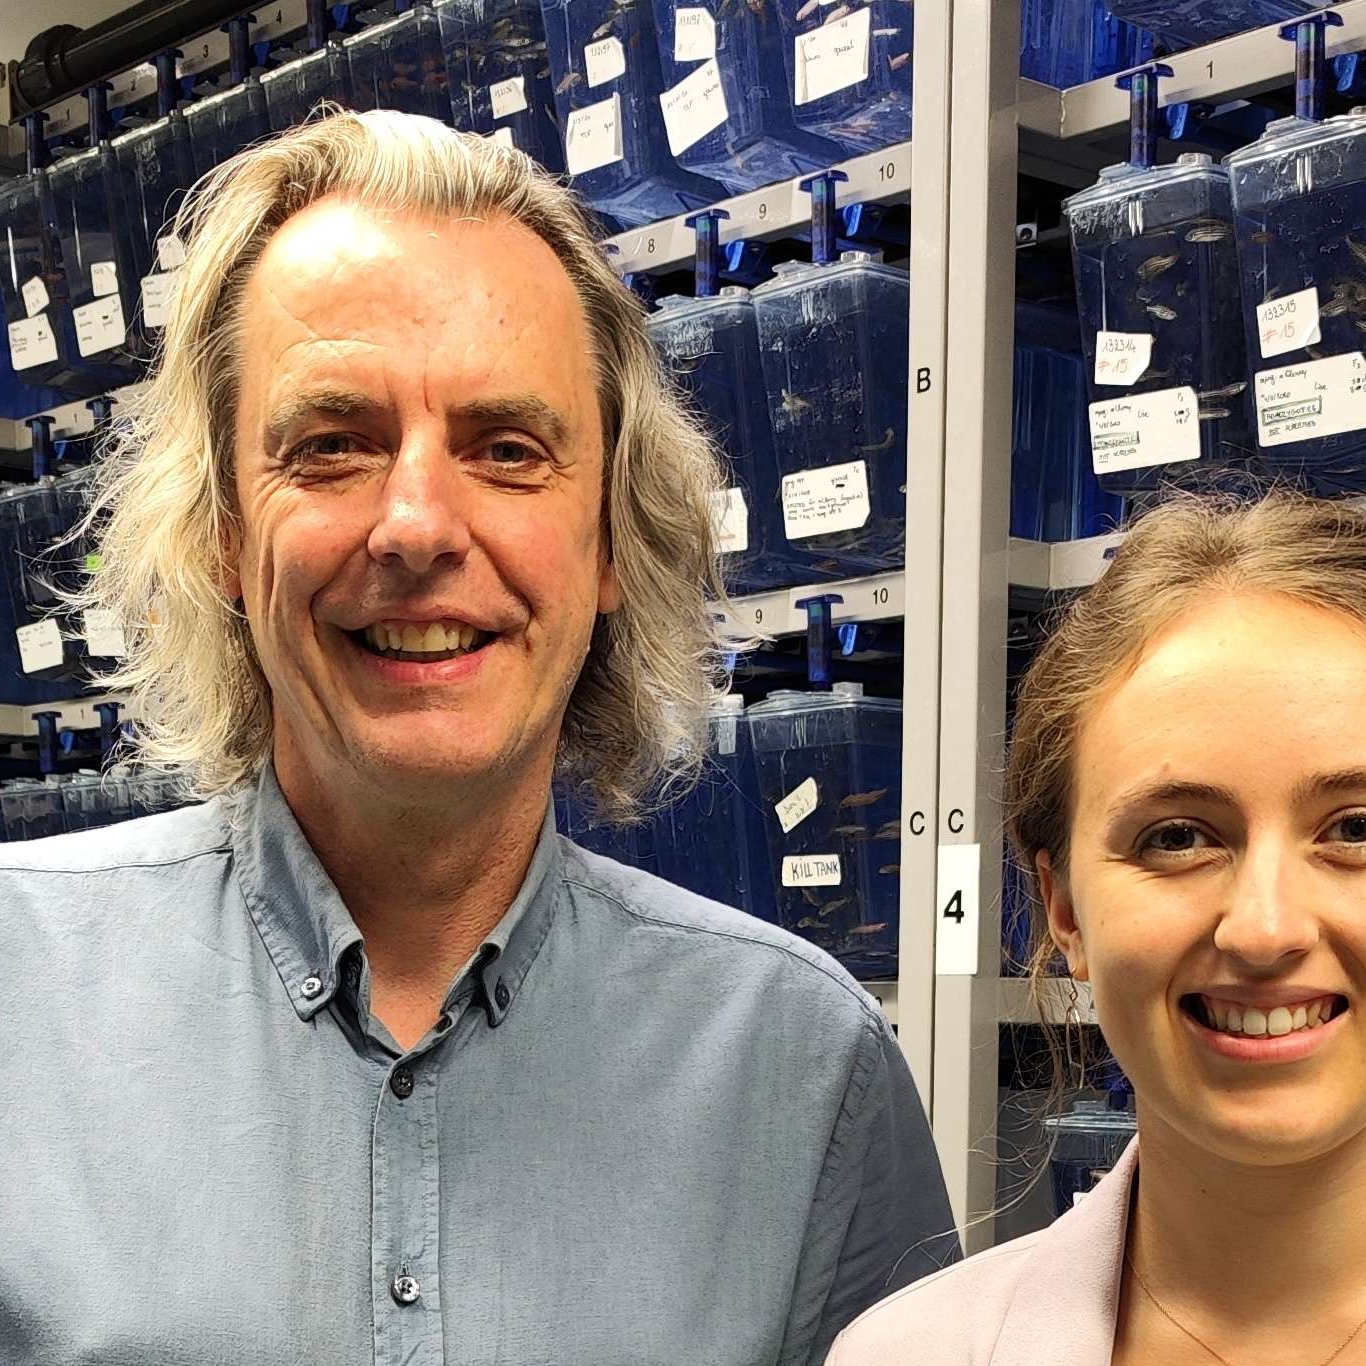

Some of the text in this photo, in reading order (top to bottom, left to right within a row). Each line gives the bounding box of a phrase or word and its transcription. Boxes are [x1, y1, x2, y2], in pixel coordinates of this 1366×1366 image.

[276, 11, 282, 23] 4
[203, 45, 209, 57] 3
[1207, 61, 1214, 79] 1
[879, 163, 895, 182] 10
[759, 203, 767, 220] 9
[647, 239, 655, 254] 8
[917, 368, 932, 394] B
[873, 588, 888, 604] 10
[755, 609, 762, 623] 9
[910, 811, 925, 835] C
[948, 809, 964, 833] C
[792, 861, 838, 880] KILL TANK
[944, 890, 964, 924] 4
